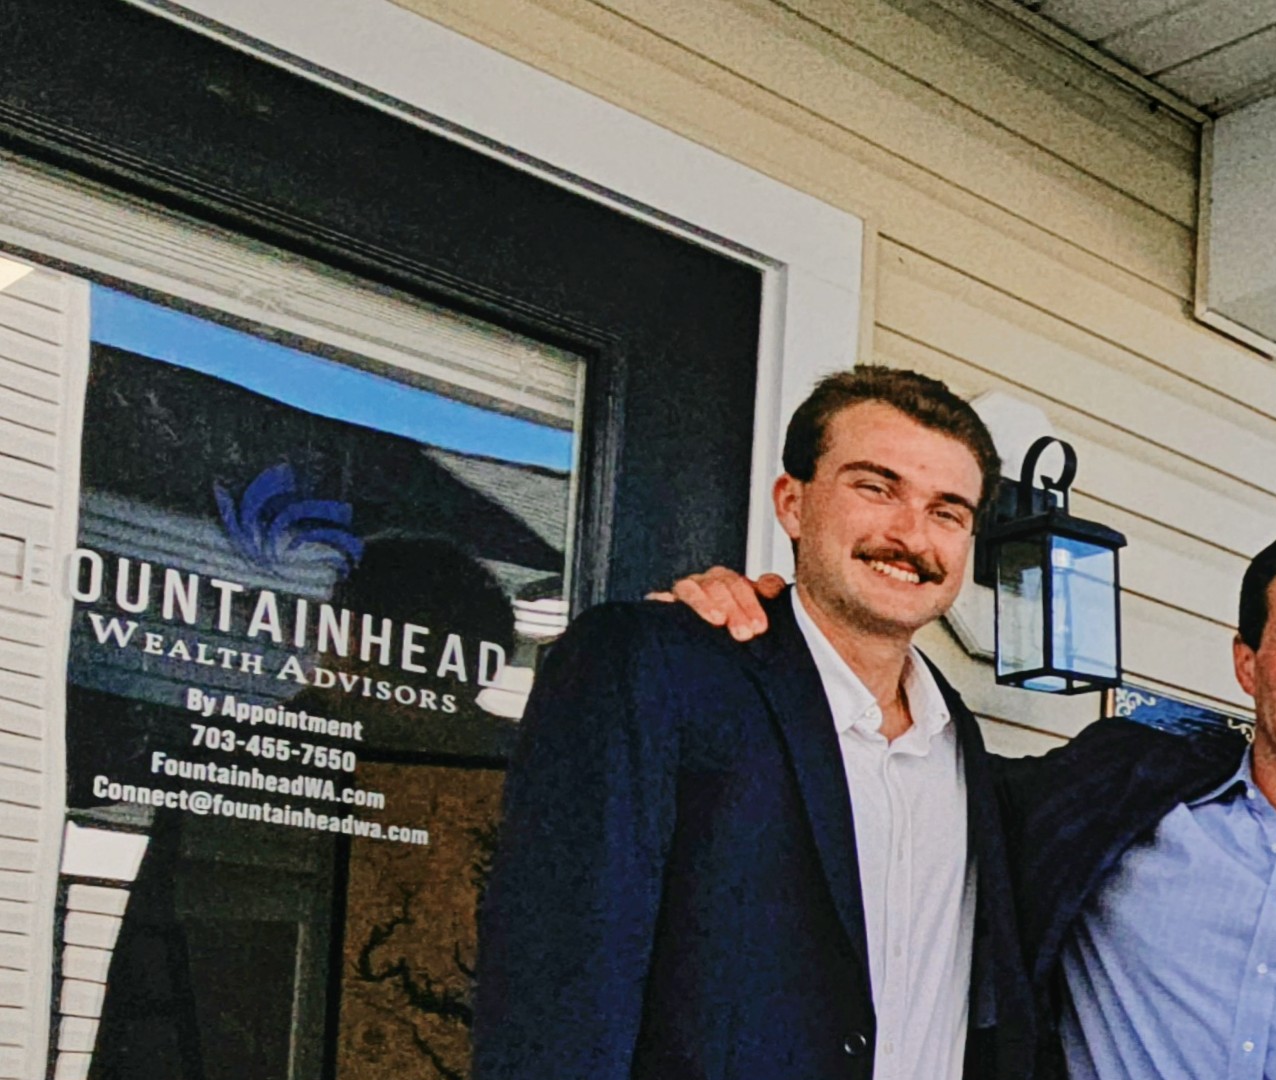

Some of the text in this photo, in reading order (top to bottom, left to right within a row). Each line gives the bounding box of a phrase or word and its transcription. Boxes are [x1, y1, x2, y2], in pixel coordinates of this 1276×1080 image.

[186, 687, 363, 741] By Appointment
[190, 723, 357, 773] 703-455-7550
[151, 751, 386, 810] FountainheadWA.com
[92, 775, 430, 846] Connect@fountainheadwa.com
